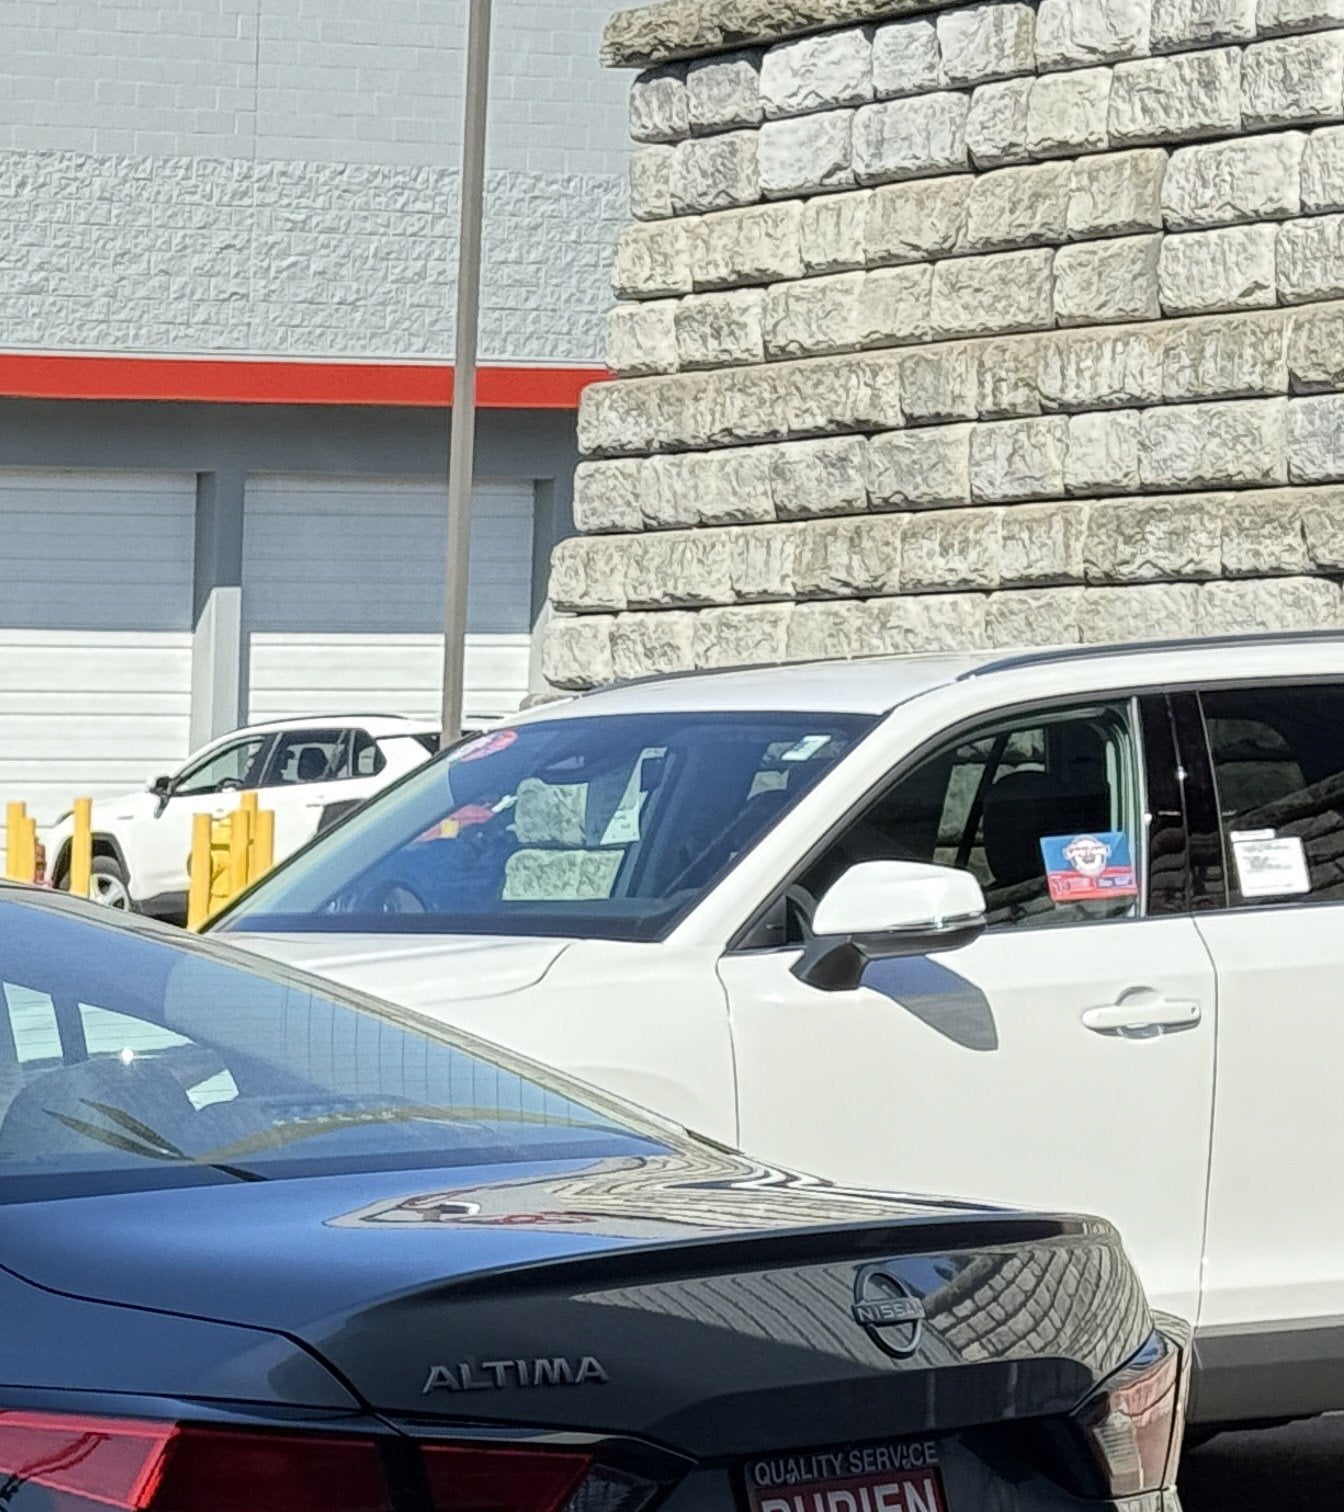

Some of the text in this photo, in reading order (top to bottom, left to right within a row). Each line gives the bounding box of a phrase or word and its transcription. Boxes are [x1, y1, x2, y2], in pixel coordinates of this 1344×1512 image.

[857, 1300, 924, 1321] NISSAN
[422, 1356, 609, 1394] ALTIMA
[754, 1442, 939, 1485] QUALITY SERVICE
